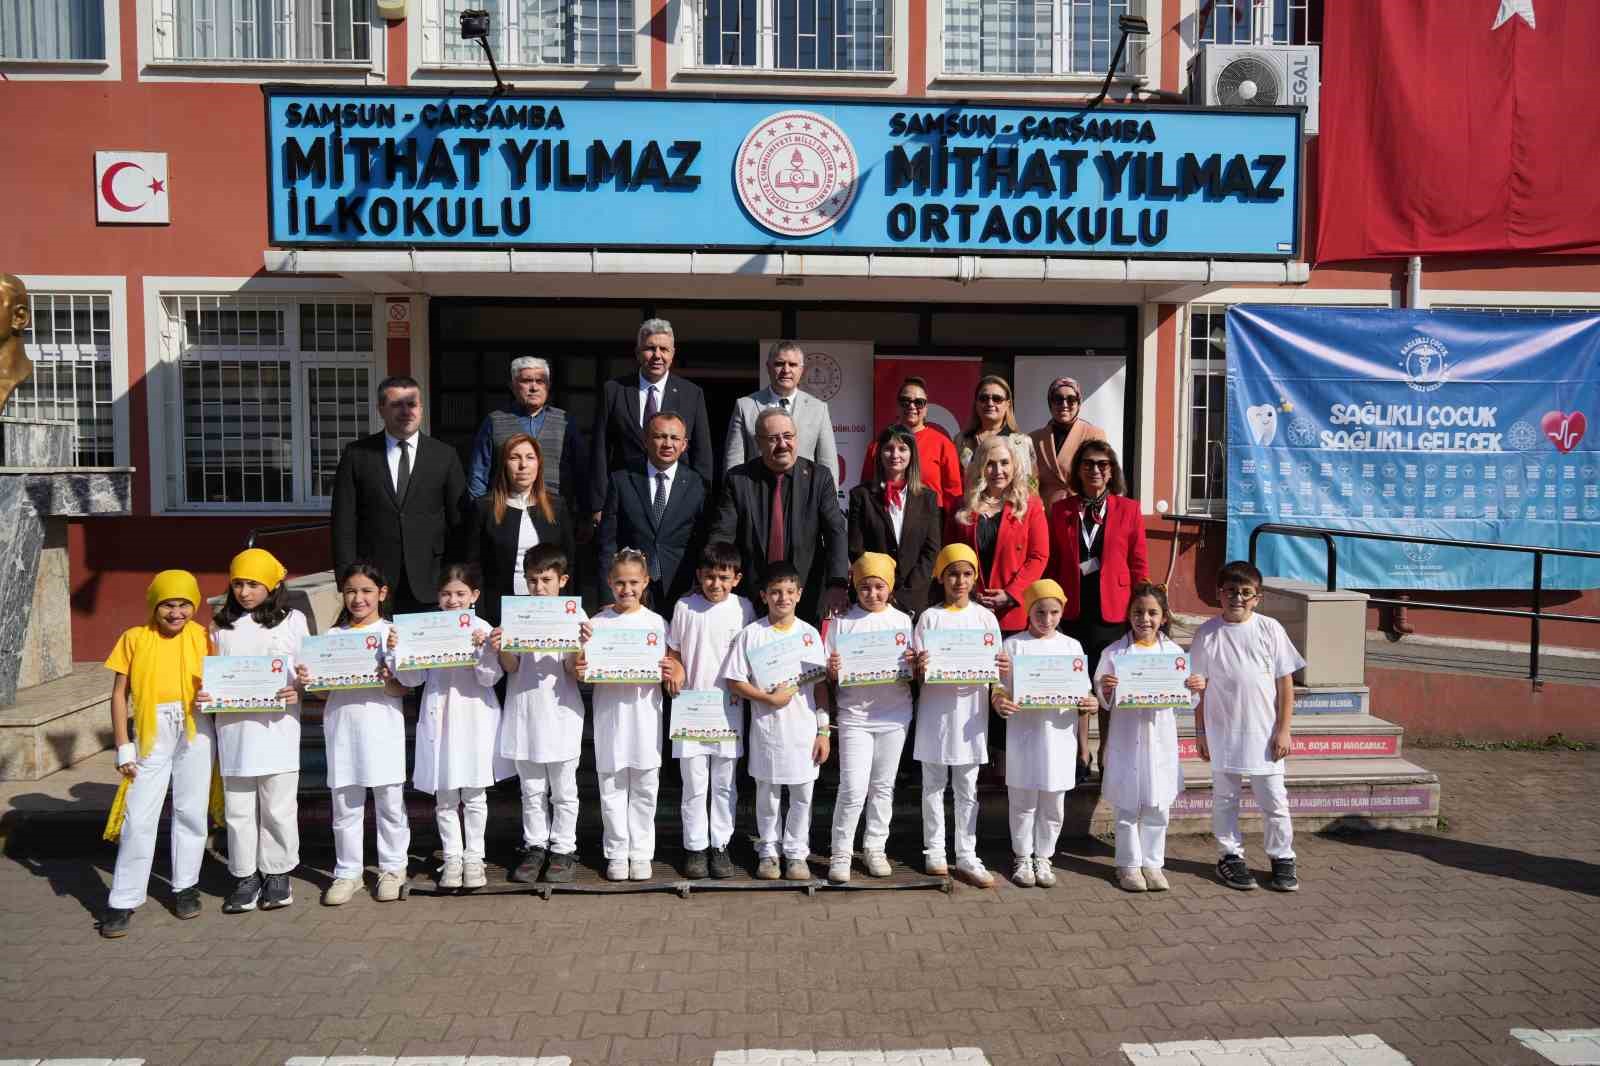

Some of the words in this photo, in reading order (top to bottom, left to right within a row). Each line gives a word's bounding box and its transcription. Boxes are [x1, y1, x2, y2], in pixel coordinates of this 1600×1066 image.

[1293, 55, 1308, 106] EGAL
[286, 103, 395, 127] SAMSUN
[420, 103, 565, 131] ÇARŞAMBA
[889, 112, 996, 138] SAMSUN
[1018, 115, 1156, 144] ÇARŞAMBA
[283, 125, 490, 188] MİTHAT
[499, 138, 701, 191] YILMAZ
[885, 136, 1088, 198] MİTHAT
[1094, 150, 1286, 203] YILMAZ
[288, 187, 531, 236] İLKOKULU
[886, 203, 1168, 247] ORTAOKULU
[1329, 401, 1423, 427] SAĞLIKLI
[1426, 404, 1497, 429] ÇOCUK
[1319, 427, 1413, 451] SAĞLIKLI
[1418, 431, 1503, 451] GELECEK
